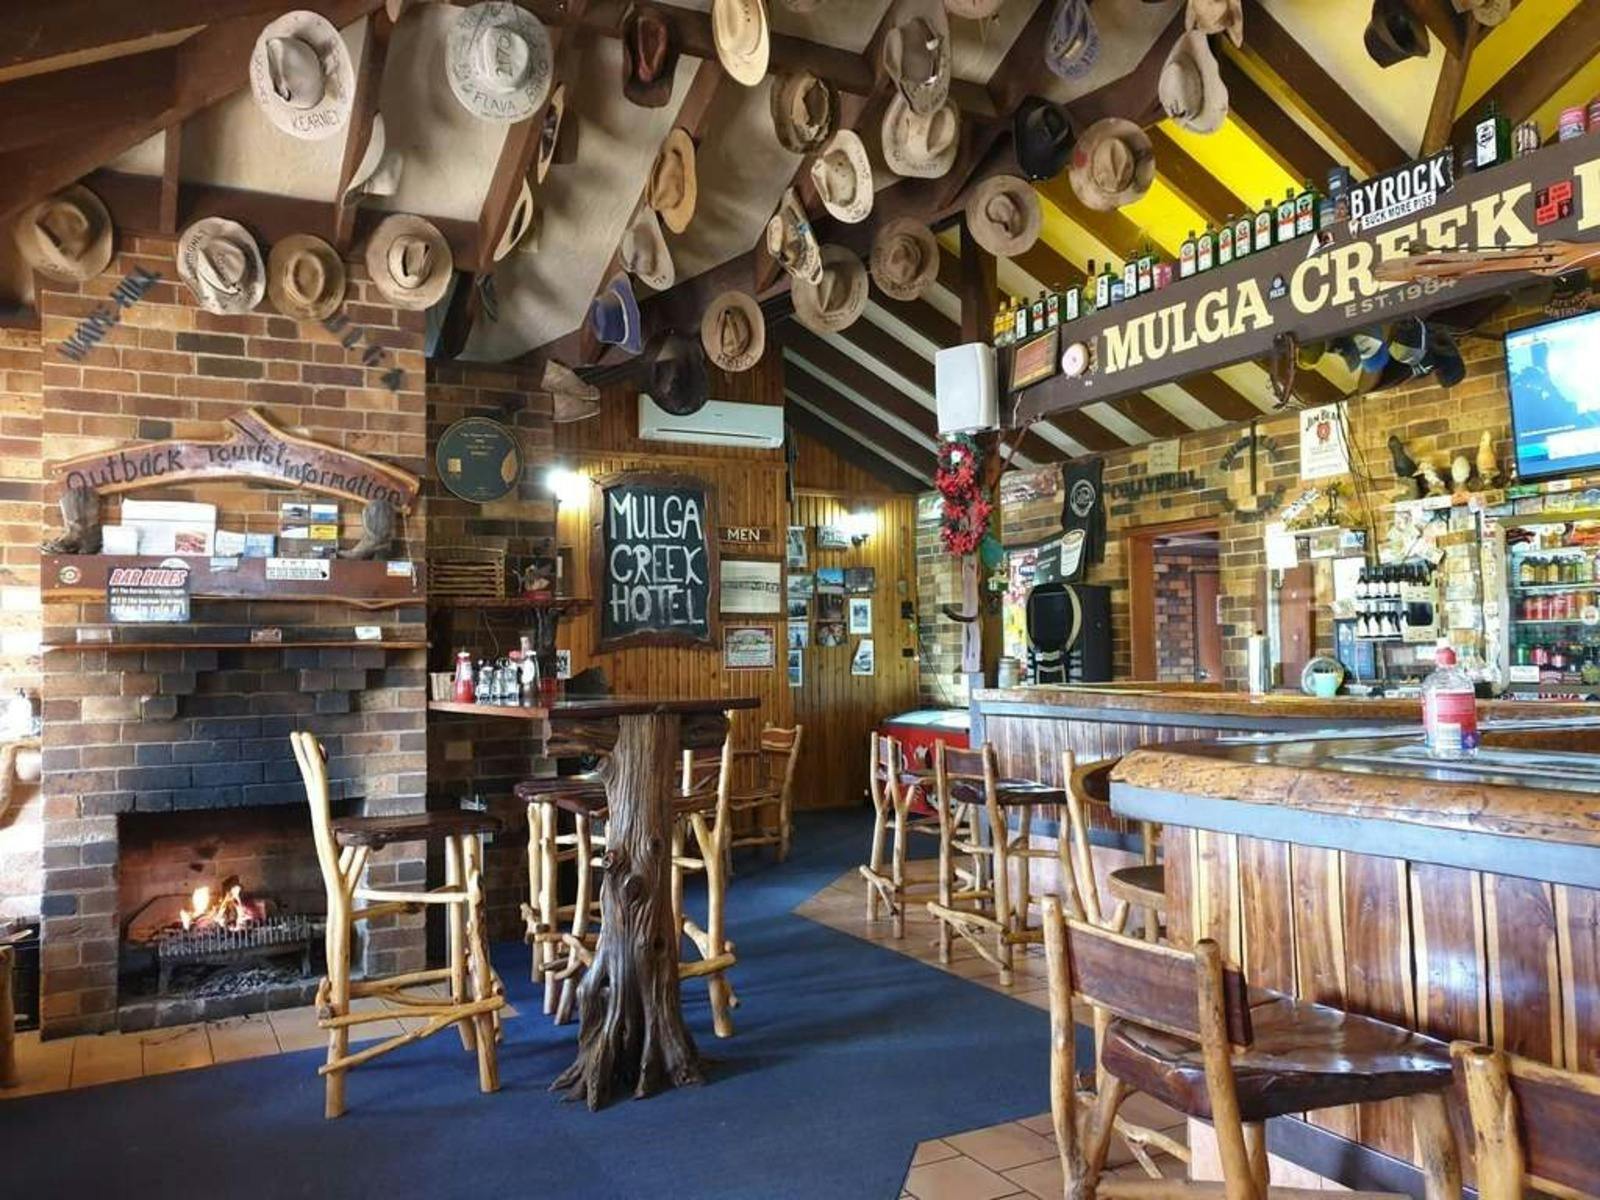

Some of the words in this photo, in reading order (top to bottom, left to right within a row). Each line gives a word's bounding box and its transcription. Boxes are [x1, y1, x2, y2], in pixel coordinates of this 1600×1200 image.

[1350, 156, 1446, 219] BYROCK
[1365, 211, 1386, 226] SUCK
[1388, 202, 1411, 217] MORE
[1414, 194, 1433, 209] PISS
[1345, 293, 1393, 319] EST.
[1103, 278, 1274, 375] MULGA
[197, 439, 287, 467] Tourist
[609, 491, 703, 540] MULGA
[727, 528, 760, 541] MEN
[108, 568, 142, 587] BAR
[140, 568, 188, 587] RULES
[610, 544, 703, 585] CREEK
[609, 584, 704, 625] HOTEL
